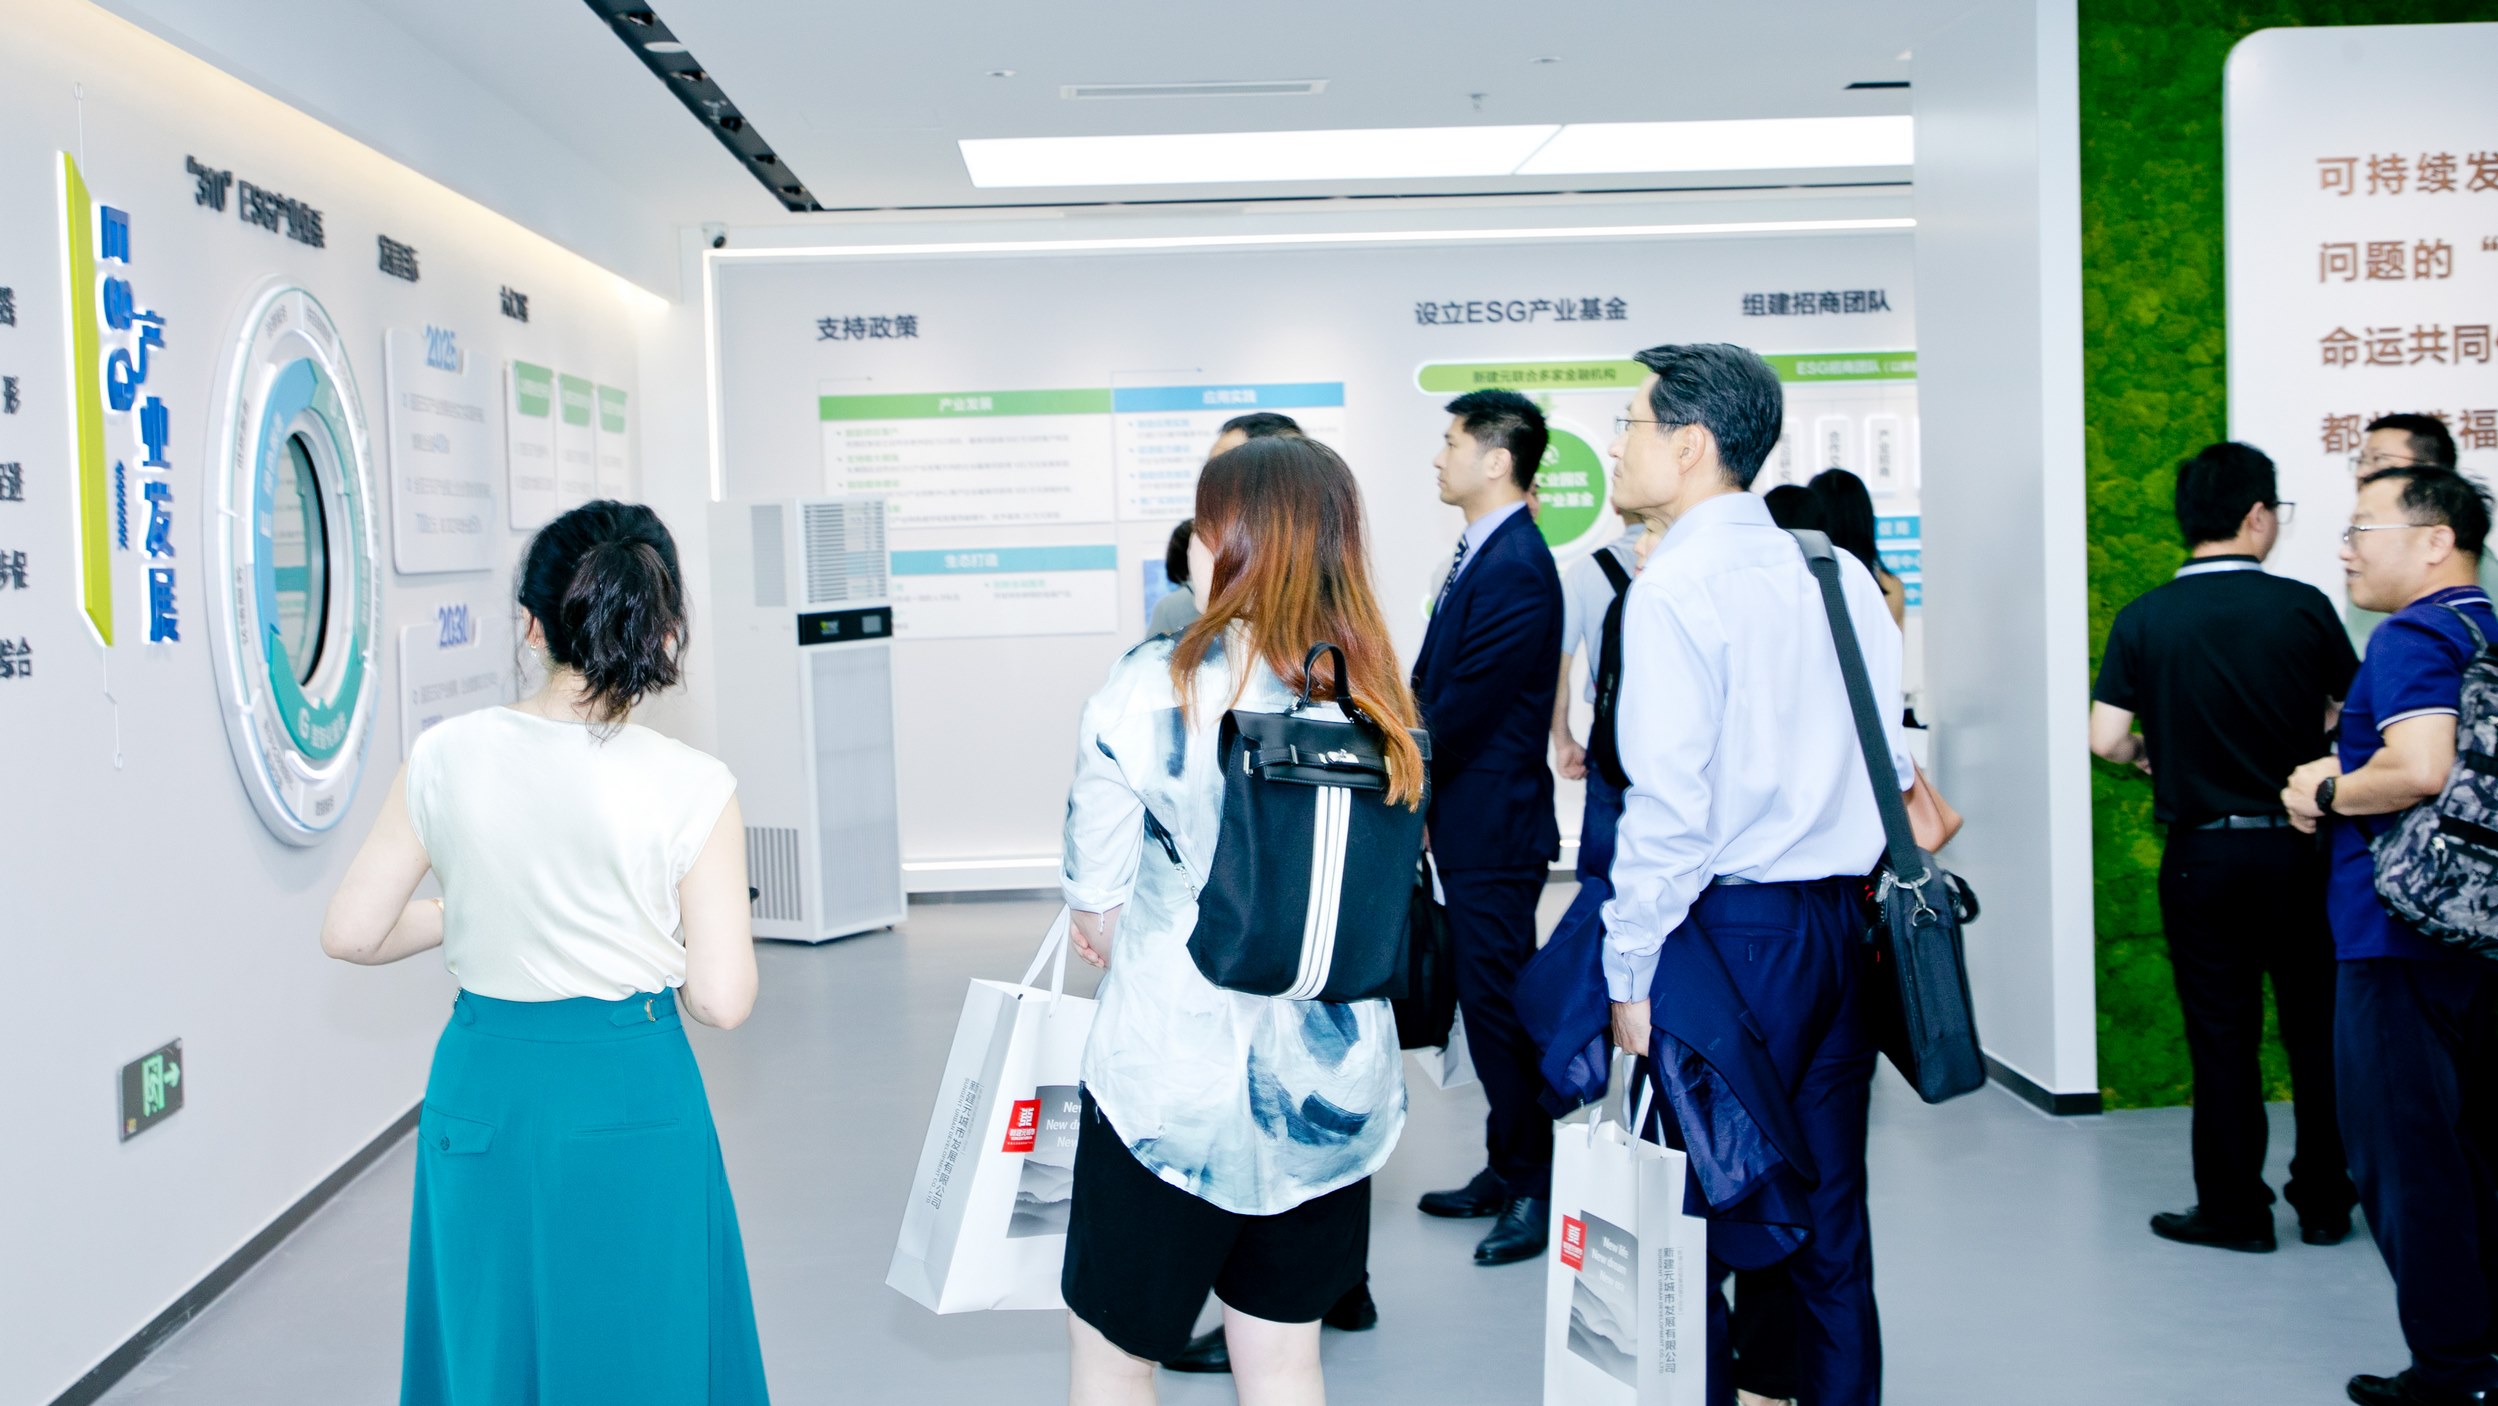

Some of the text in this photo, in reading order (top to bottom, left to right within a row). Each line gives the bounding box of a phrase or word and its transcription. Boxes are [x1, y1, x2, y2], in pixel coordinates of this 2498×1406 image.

[1415, 296, 1629, 326] 设立ESG产业基金
[1742, 289, 1892, 317] 组建招商团队
[816, 314, 919, 341] 支持政策
[2319, 323, 2498, 368] 命运共同
[1045, 1118, 1067, 1131] New
[931, 1080, 980, 1210] 新建元城市发展有限公司
[1663, 1247, 1676, 1374] 新建元城市发展有限公司
